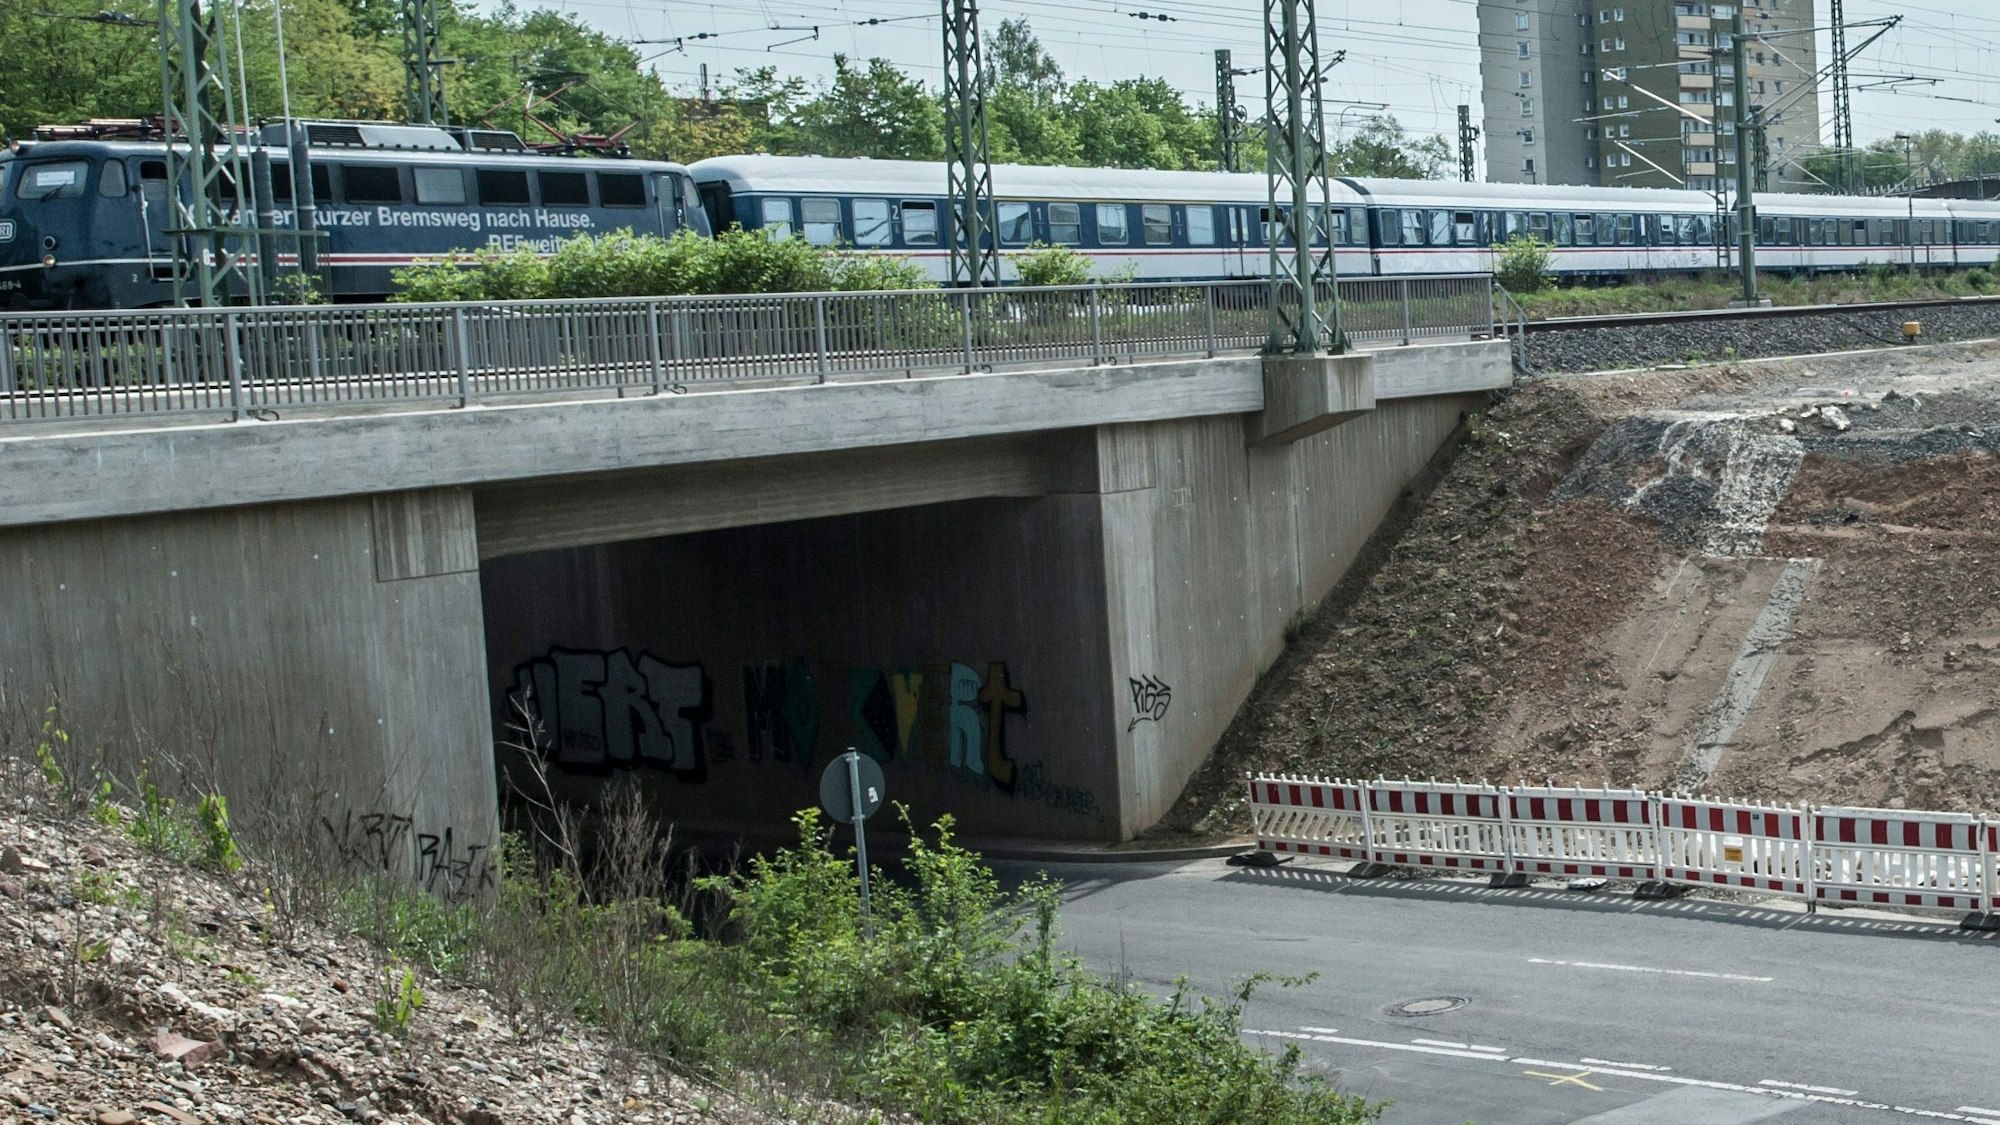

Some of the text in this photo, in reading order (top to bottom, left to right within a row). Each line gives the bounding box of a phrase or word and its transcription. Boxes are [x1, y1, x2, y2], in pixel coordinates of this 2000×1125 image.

[377, 206, 481, 231] Bremsweg
[486, 210, 531, 228] nach
[535, 209, 596, 229] Hause.
[891, 205, 900, 220] 2
